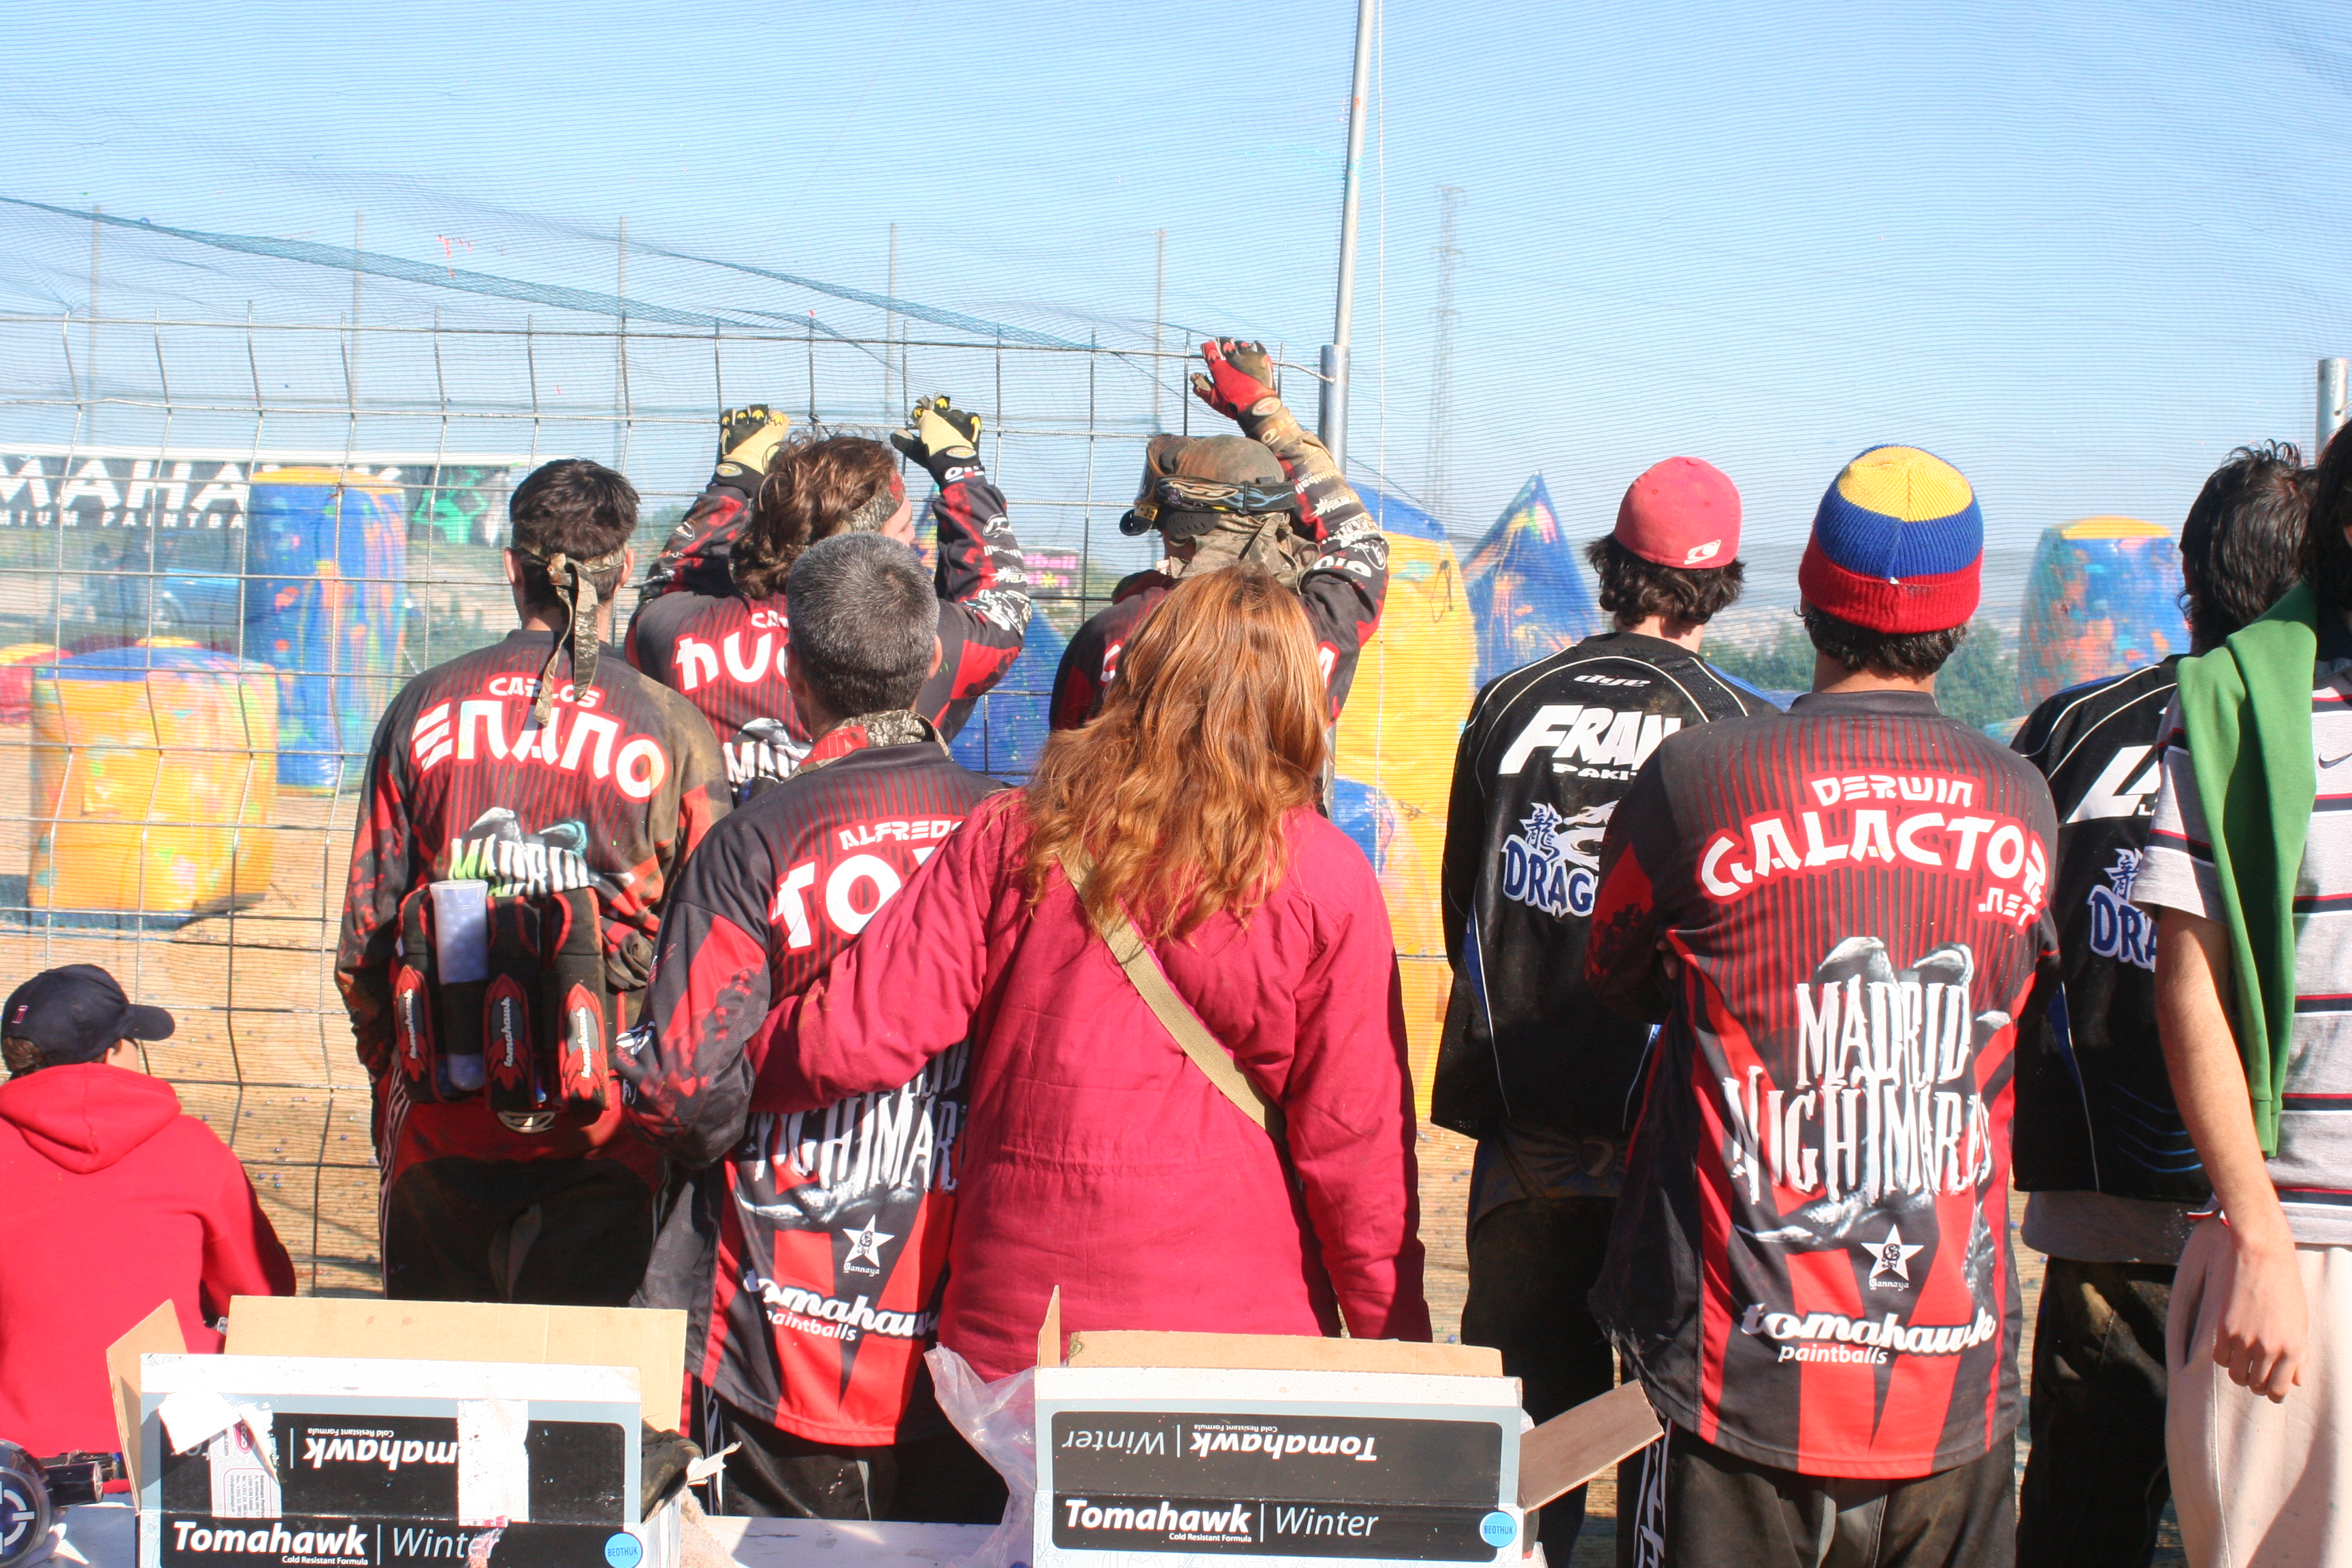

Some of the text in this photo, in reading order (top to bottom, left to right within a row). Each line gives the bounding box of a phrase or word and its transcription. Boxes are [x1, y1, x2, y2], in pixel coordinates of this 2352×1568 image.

[1573, 674, 1652, 687] dye
[1552, 763, 1637, 781] PAKI
[1811, 774, 1974, 808] DERWIN
[838, 820, 962, 850] ALFRED
[1701, 810, 2046, 903] GALACTOR
[1978, 888, 2036, 926] .NET
[1795, 975, 1972, 1089] MADRID
[1740, 1302, 1997, 1354] tomahawk
[1778, 1343, 1889, 1365] paintballs
[307, 1428, 394, 1437] Cold Resistant Formula
[1062, 1431, 1377, 1461] Tomahawk Winter
[1066, 1499, 1379, 1537] Tomahawk Winter
[174, 1521, 368, 1556] Tomahawk
[1188, 1533, 1220, 1541] Resistant
[1222, 1535, 1252, 1543] Formula
[301, 1556, 336, 1565] Resistant
[337, 1557, 368, 1565] Formula
